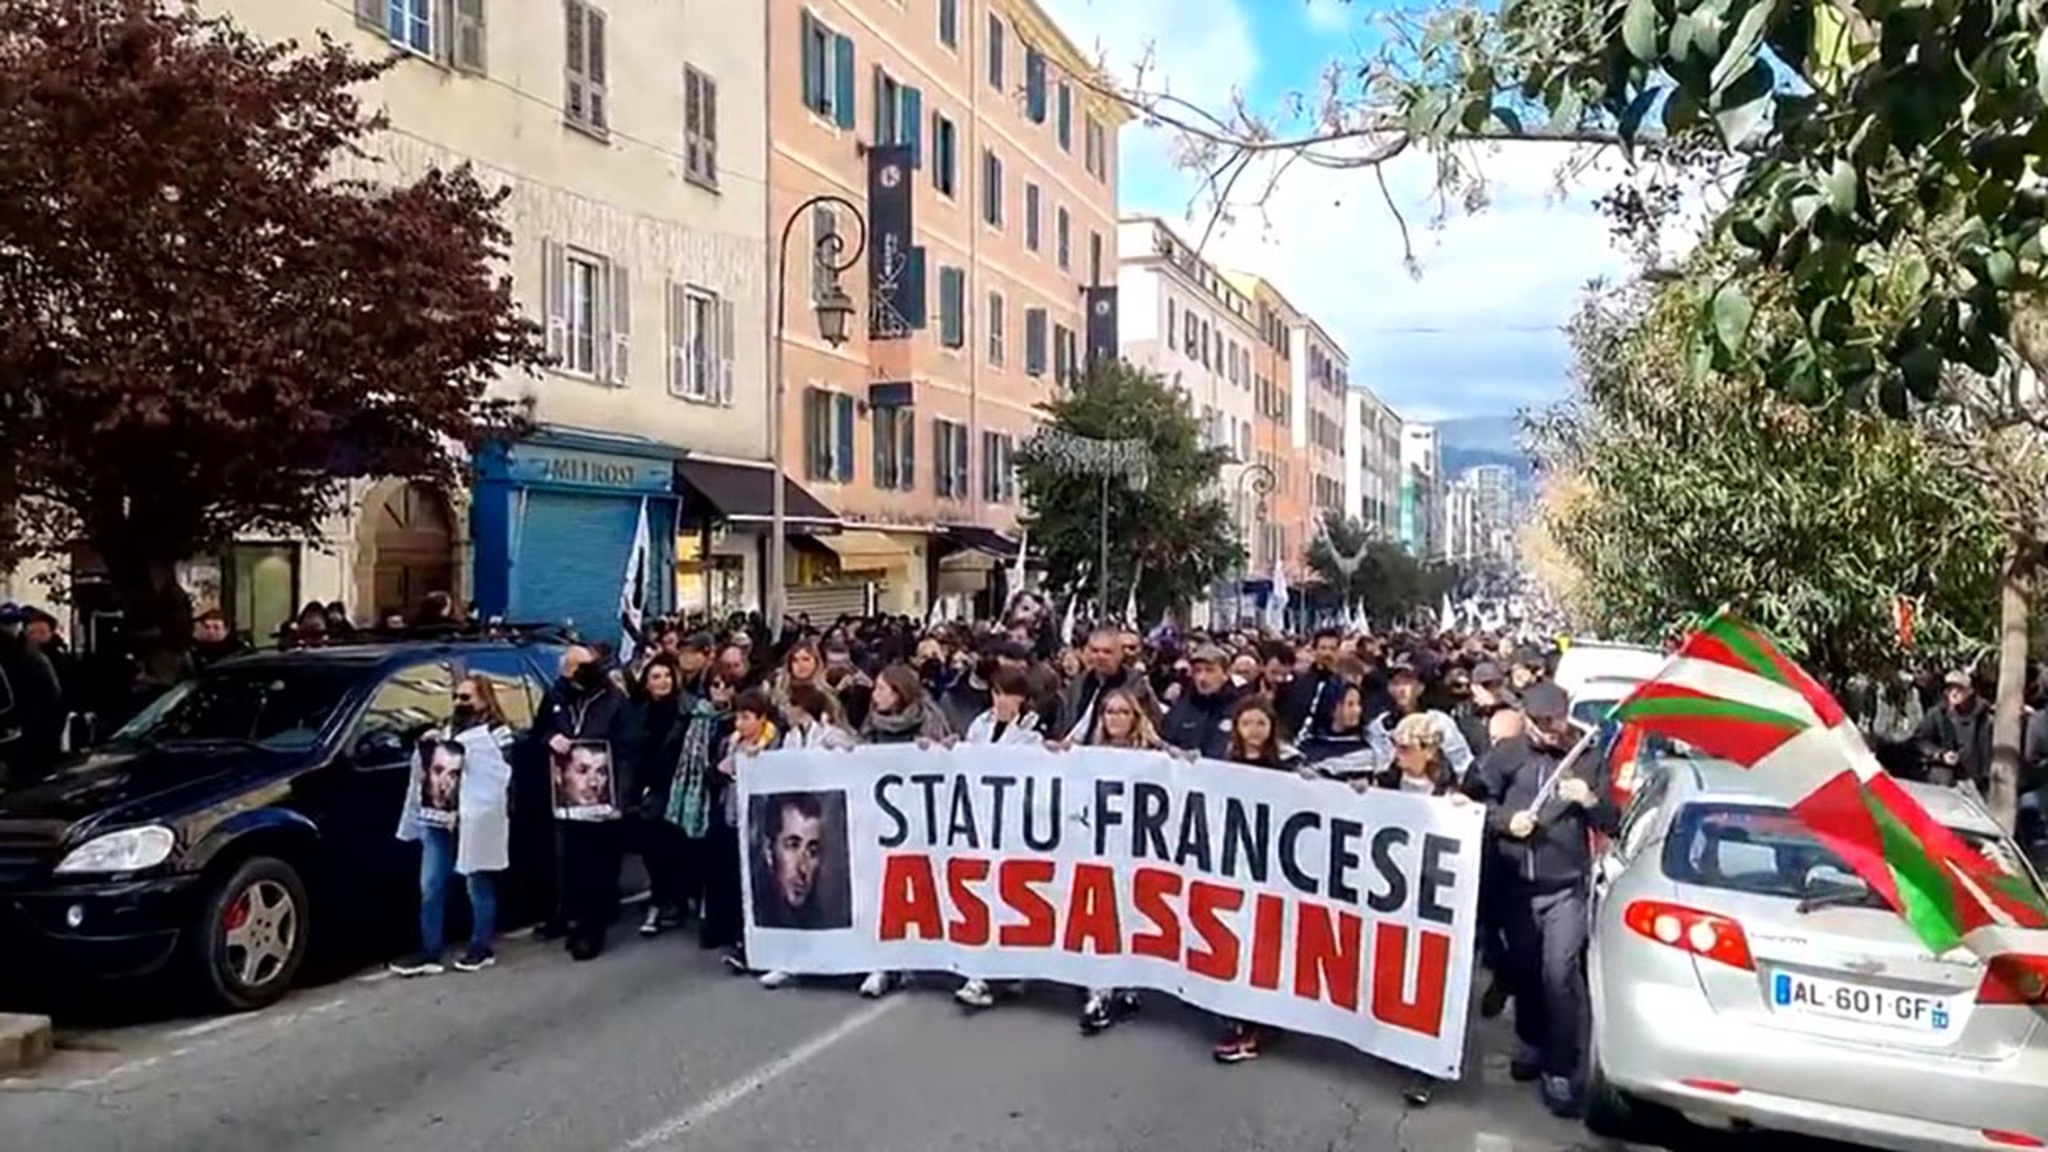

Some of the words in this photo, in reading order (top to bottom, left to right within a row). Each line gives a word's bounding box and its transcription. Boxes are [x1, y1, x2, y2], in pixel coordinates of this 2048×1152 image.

[874, 773, 1062, 852] STATU
[1095, 779, 1461, 925] FRANCESE
[879, 854, 1451, 1038] ASSASSINU
